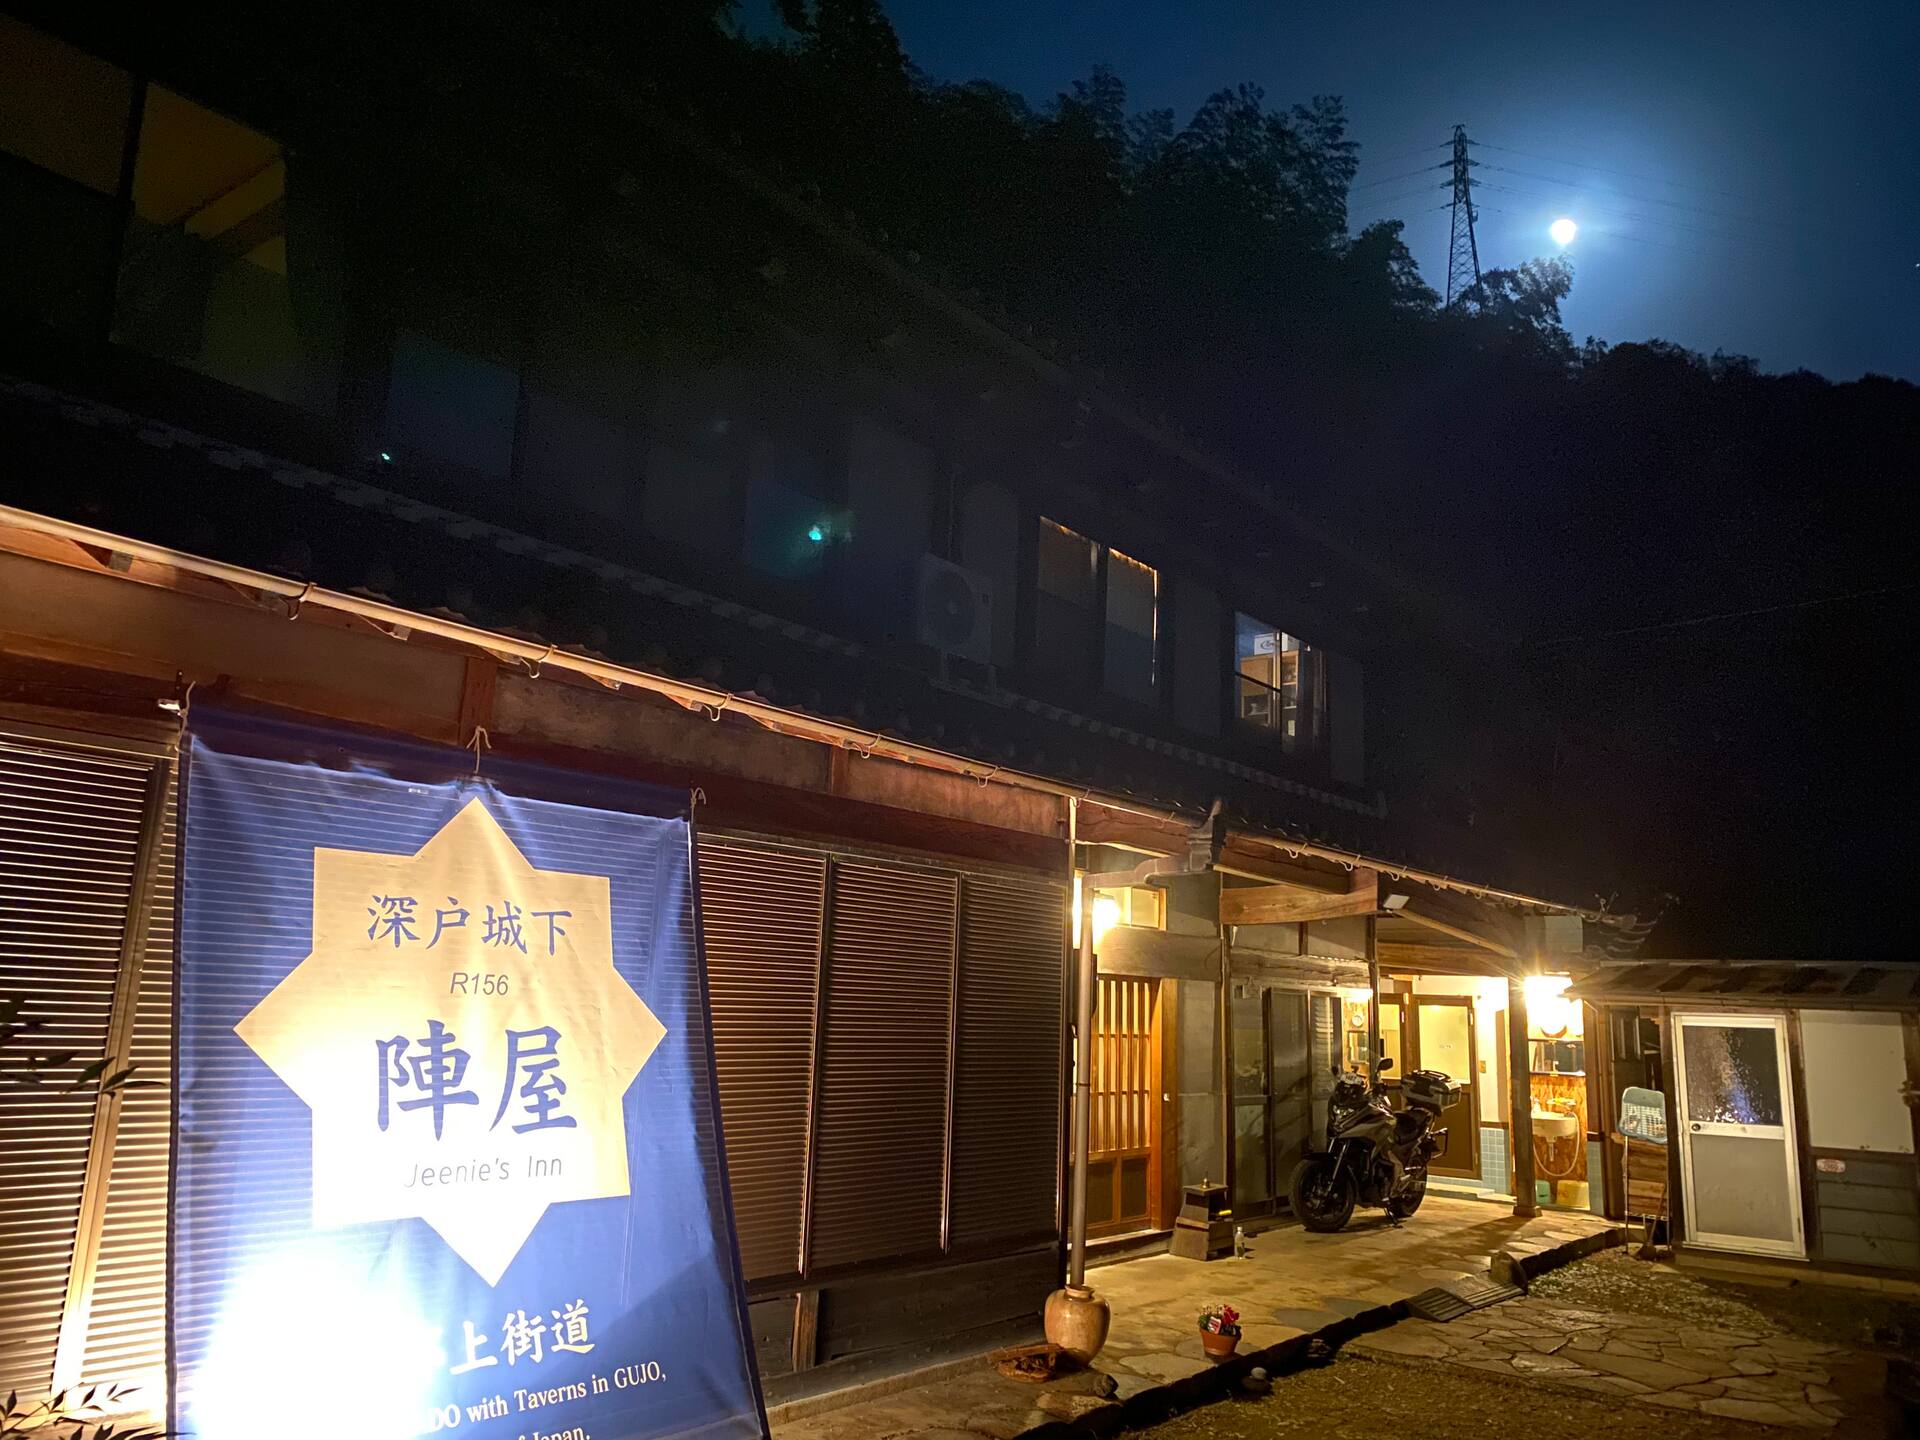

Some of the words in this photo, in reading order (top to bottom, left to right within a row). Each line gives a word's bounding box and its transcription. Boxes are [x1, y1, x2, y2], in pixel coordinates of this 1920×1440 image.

[450, 972, 509, 997] R156
[375, 1018, 578, 1142] 陣屋
[403, 1157, 510, 1189] Jeenie's
[527, 1154, 563, 1179] Inn
[424, 1298, 596, 1377] 上街道
[465, 1394, 510, 1423] with
[513, 1380, 587, 1413] Taverns
[591, 1373, 610, 1396] in
[613, 1360, 668, 1389] GUJO,
